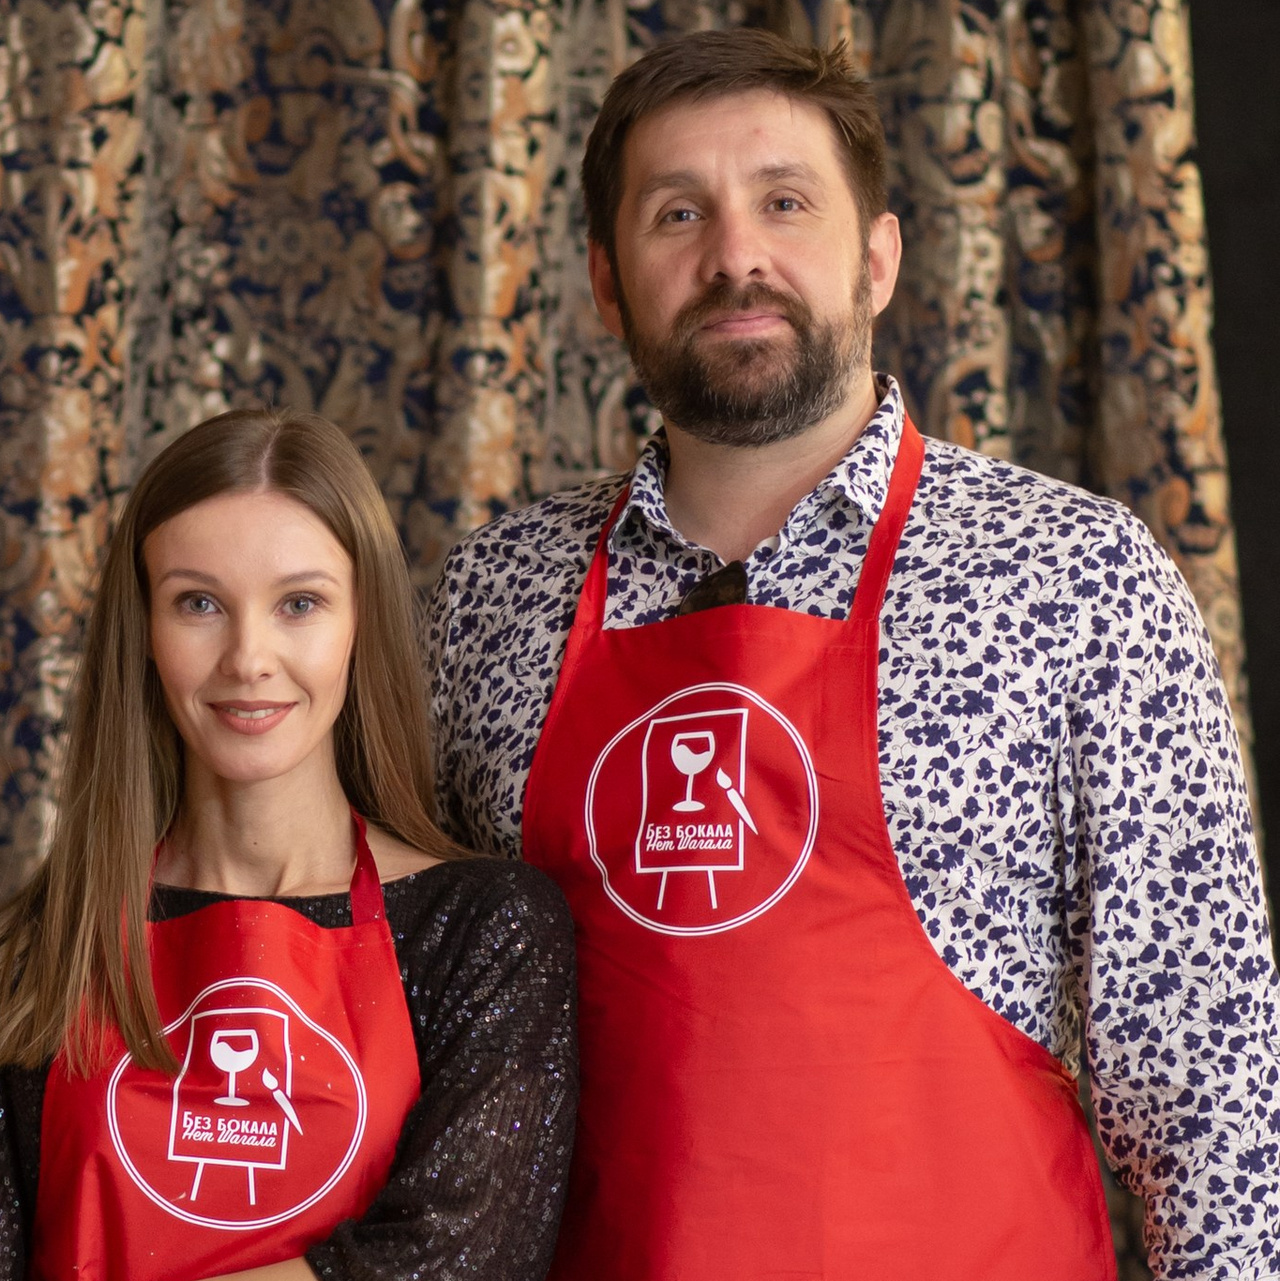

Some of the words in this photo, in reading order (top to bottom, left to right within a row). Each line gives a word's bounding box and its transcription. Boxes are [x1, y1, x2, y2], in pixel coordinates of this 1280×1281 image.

[676, 824, 734, 839] БОКАЛА
[646, 837, 675, 852] Нет
[677, 837, 733, 851] Шагала
[217, 1118, 278, 1136] БОКАЛА
[182, 1126, 215, 1142] Нет
[217, 1128, 276, 1148] Шагала
